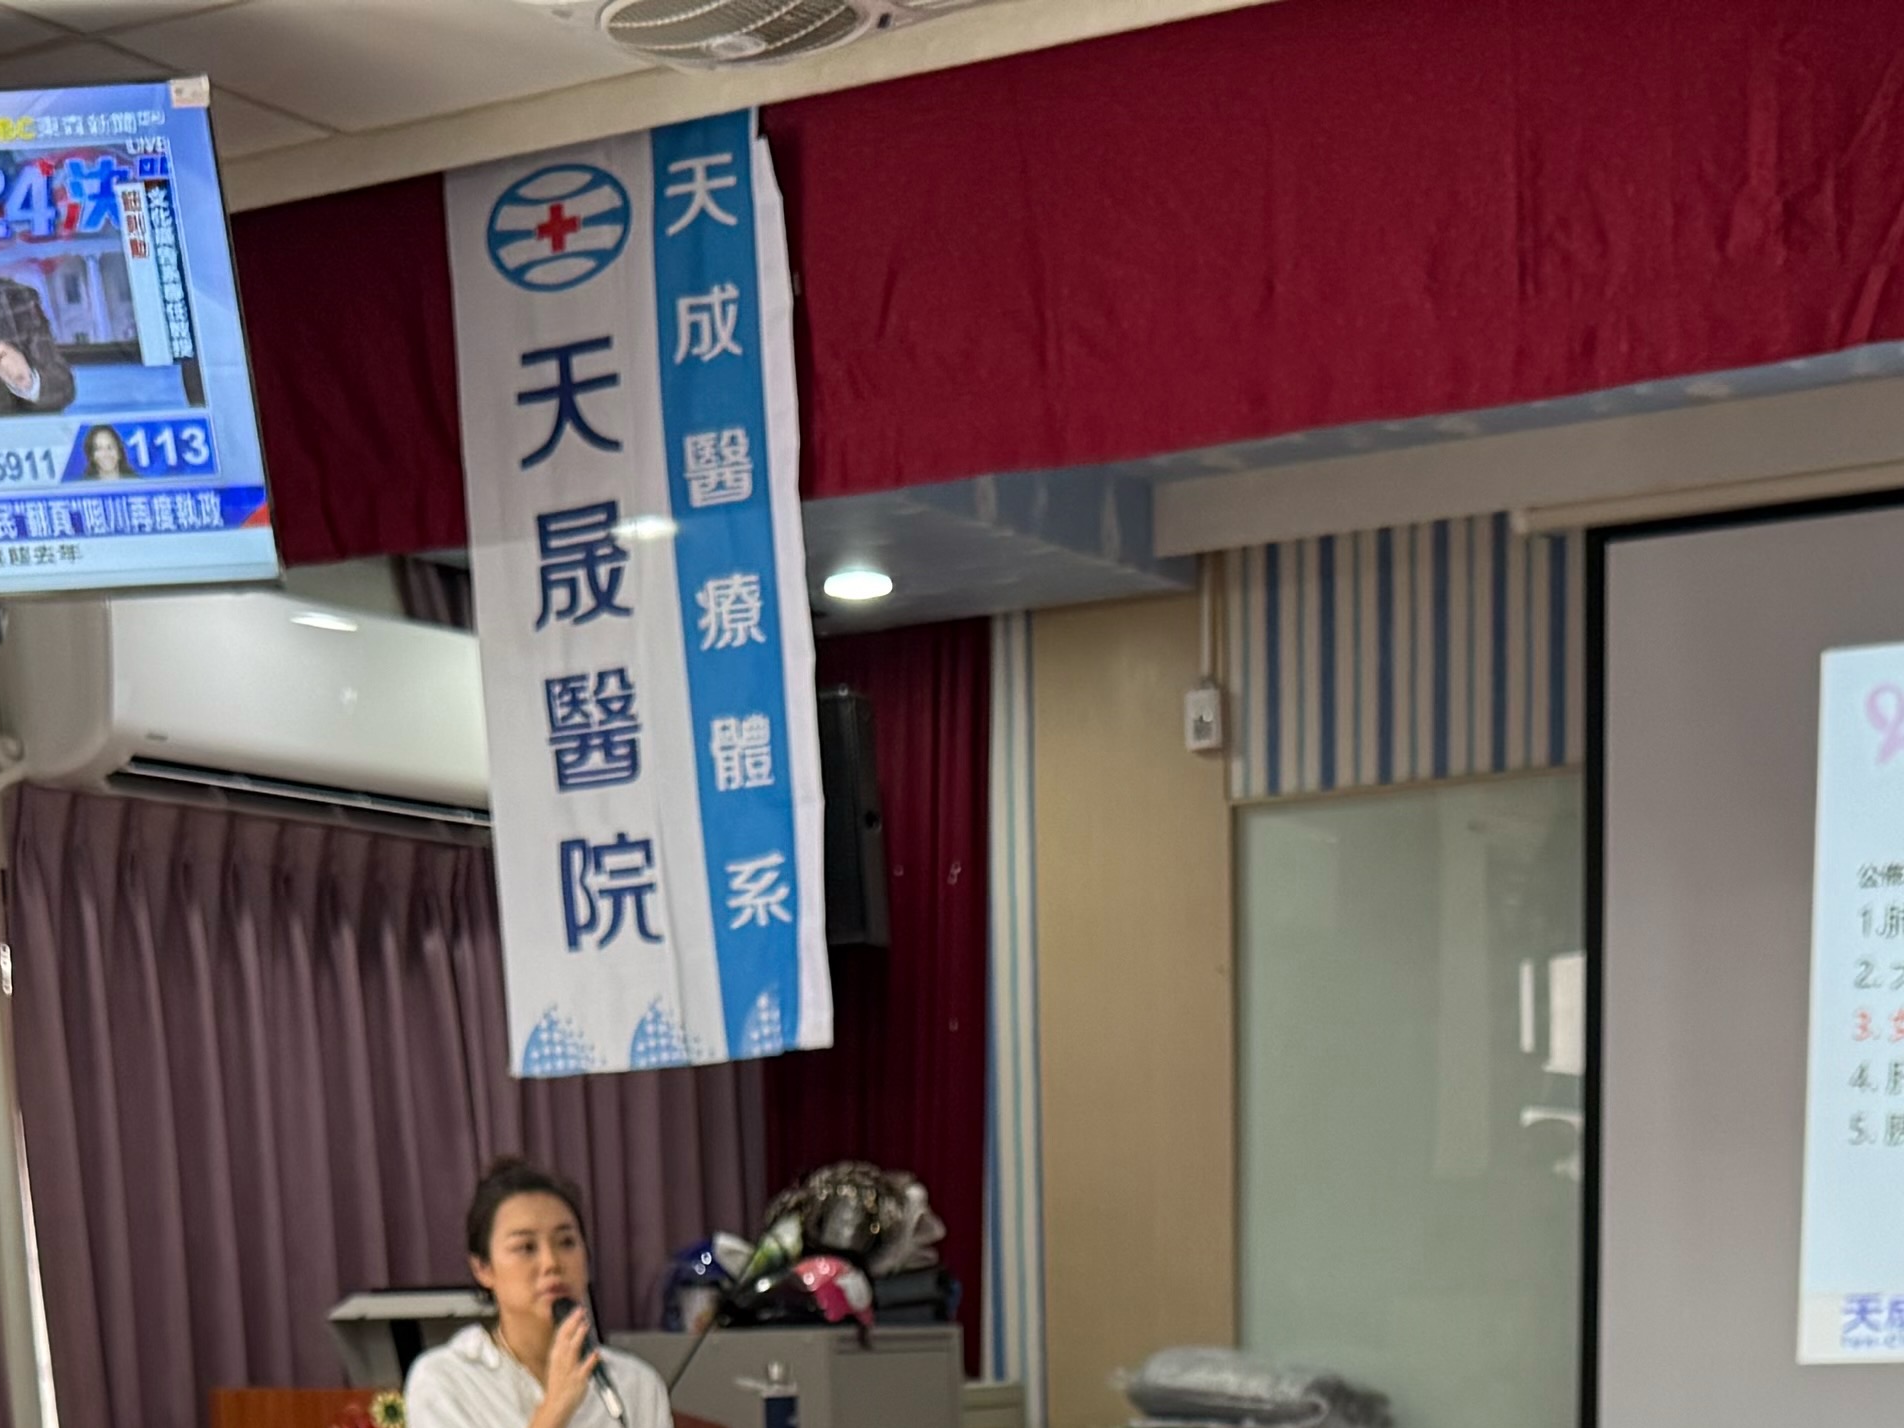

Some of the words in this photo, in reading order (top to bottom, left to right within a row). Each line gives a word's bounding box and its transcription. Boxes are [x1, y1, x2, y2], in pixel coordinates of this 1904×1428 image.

[128, 427, 211, 468] 113
[517, 334, 666, 952] 天晟醫院
[663, 151, 793, 930] 天成醫療體系
